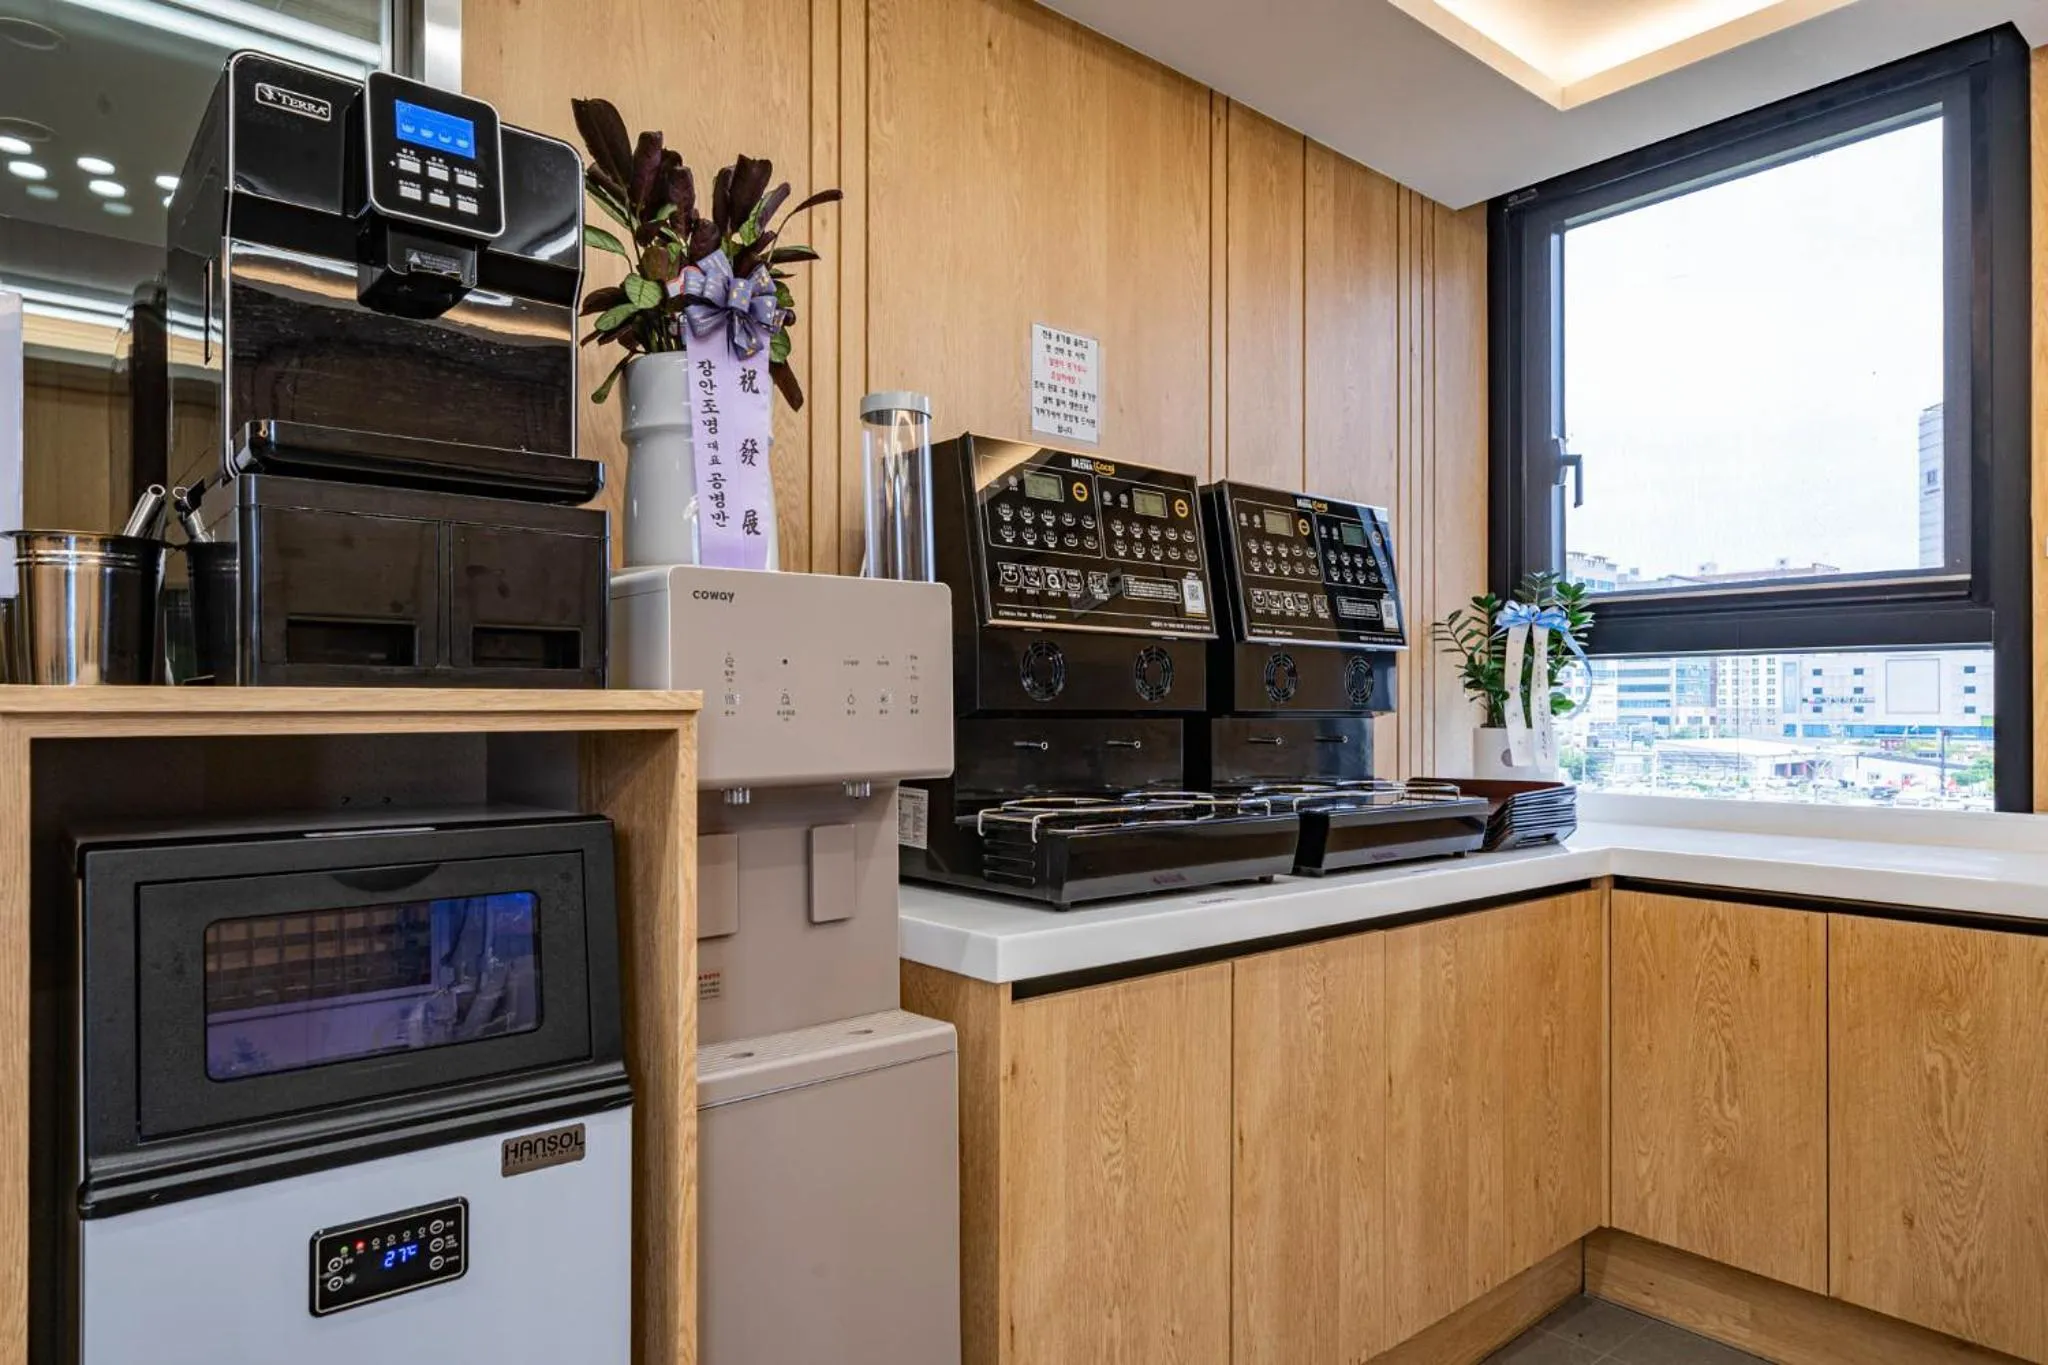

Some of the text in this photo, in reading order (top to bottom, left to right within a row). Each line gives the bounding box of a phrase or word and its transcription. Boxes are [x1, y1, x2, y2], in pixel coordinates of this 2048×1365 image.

[278, 93, 328, 115] TERRA
[707, 440, 721, 465] 대표
[693, 590, 735, 603] coway
[504, 1130, 585, 1161] HANSOL
